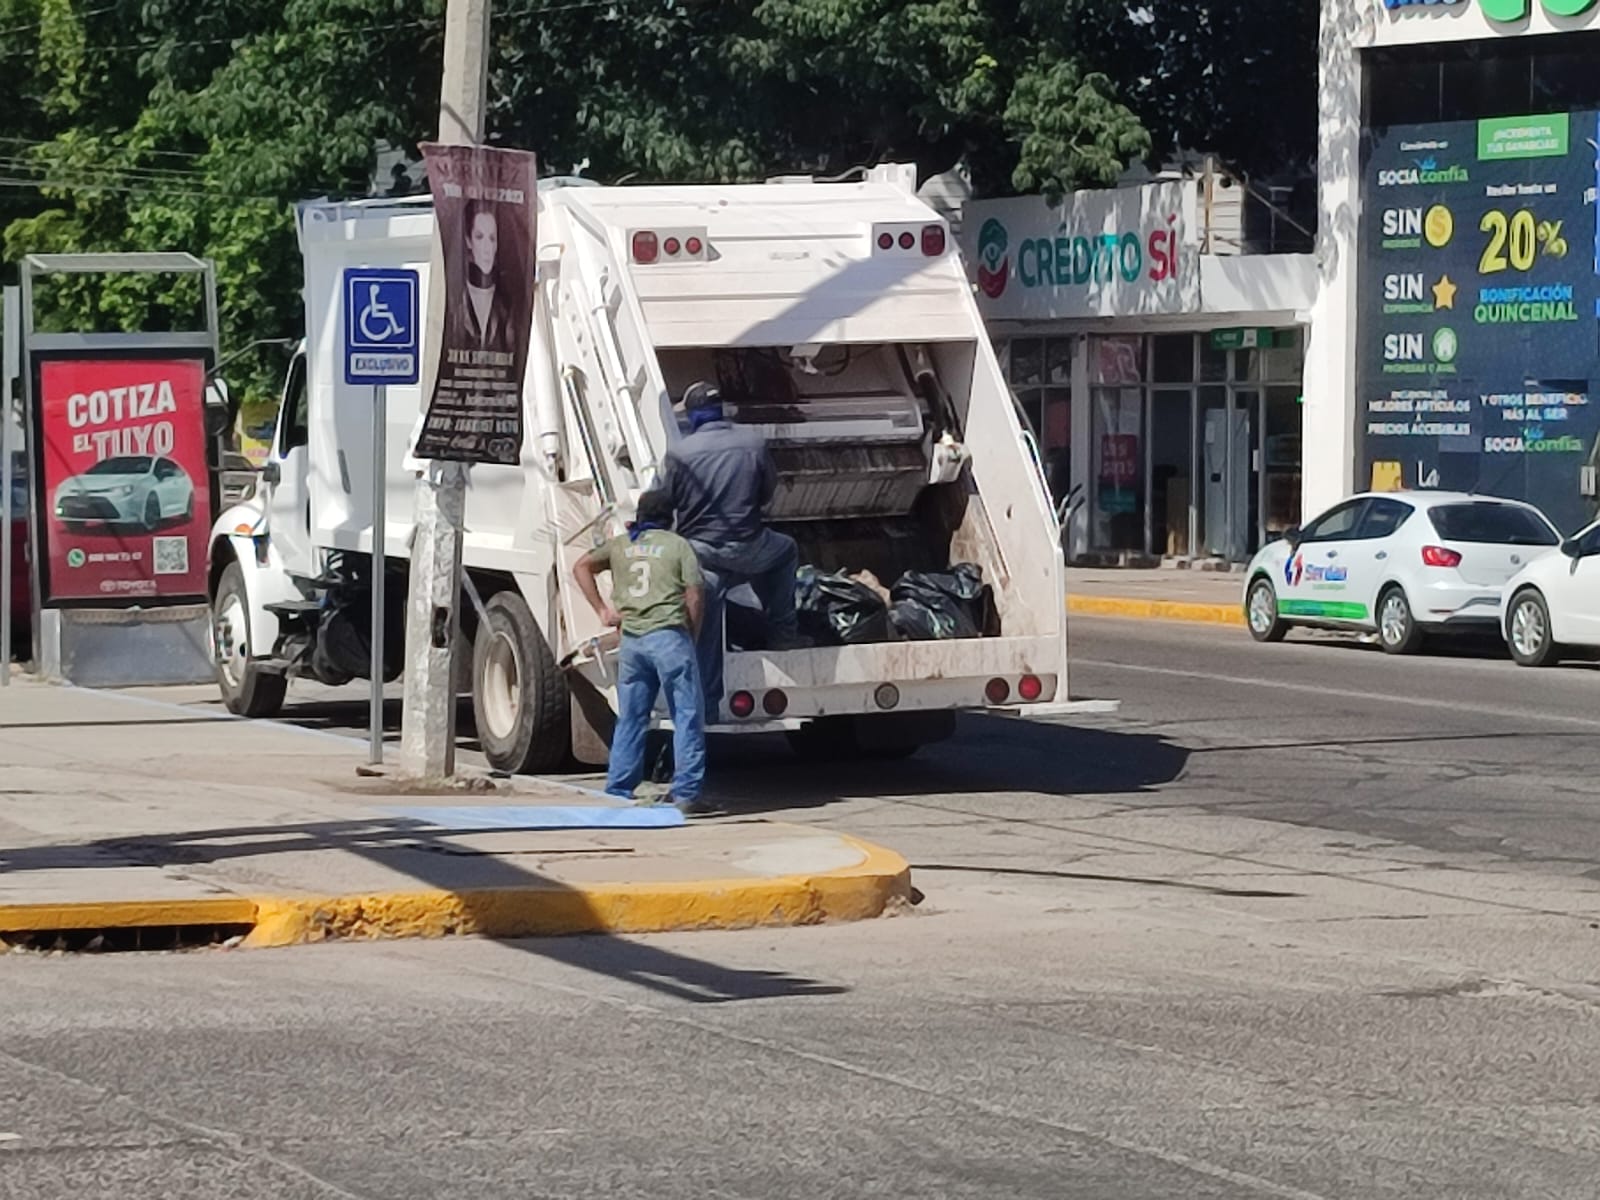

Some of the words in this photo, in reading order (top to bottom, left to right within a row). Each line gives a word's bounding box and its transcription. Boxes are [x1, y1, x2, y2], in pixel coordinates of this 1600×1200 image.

[1383, 208, 1422, 236] SIN
[1018, 223, 1142, 288] CRÉDITO
[1148, 214, 1177, 281] SÍ
[1479, 209, 1568, 274] 20%
[1384, 273, 1424, 300] SIN
[1480, 283, 1573, 301] BONIFICACIÓN
[1474, 301, 1578, 323] QUINCENAL
[1384, 333, 1424, 360] SIN
[355, 357, 409, 371] EXCLUSIVO
[67, 380, 177, 428] COTIZA
[1480, 395, 1488, 406] Y
[1526, 409, 1542, 420] AL
[1544, 408, 1568, 420] SER
[73, 434, 92, 453] EL
[92, 421, 174, 462] TUYO
[116, 580, 157, 591] TOYOTA
[628, 561, 651, 597] 3
